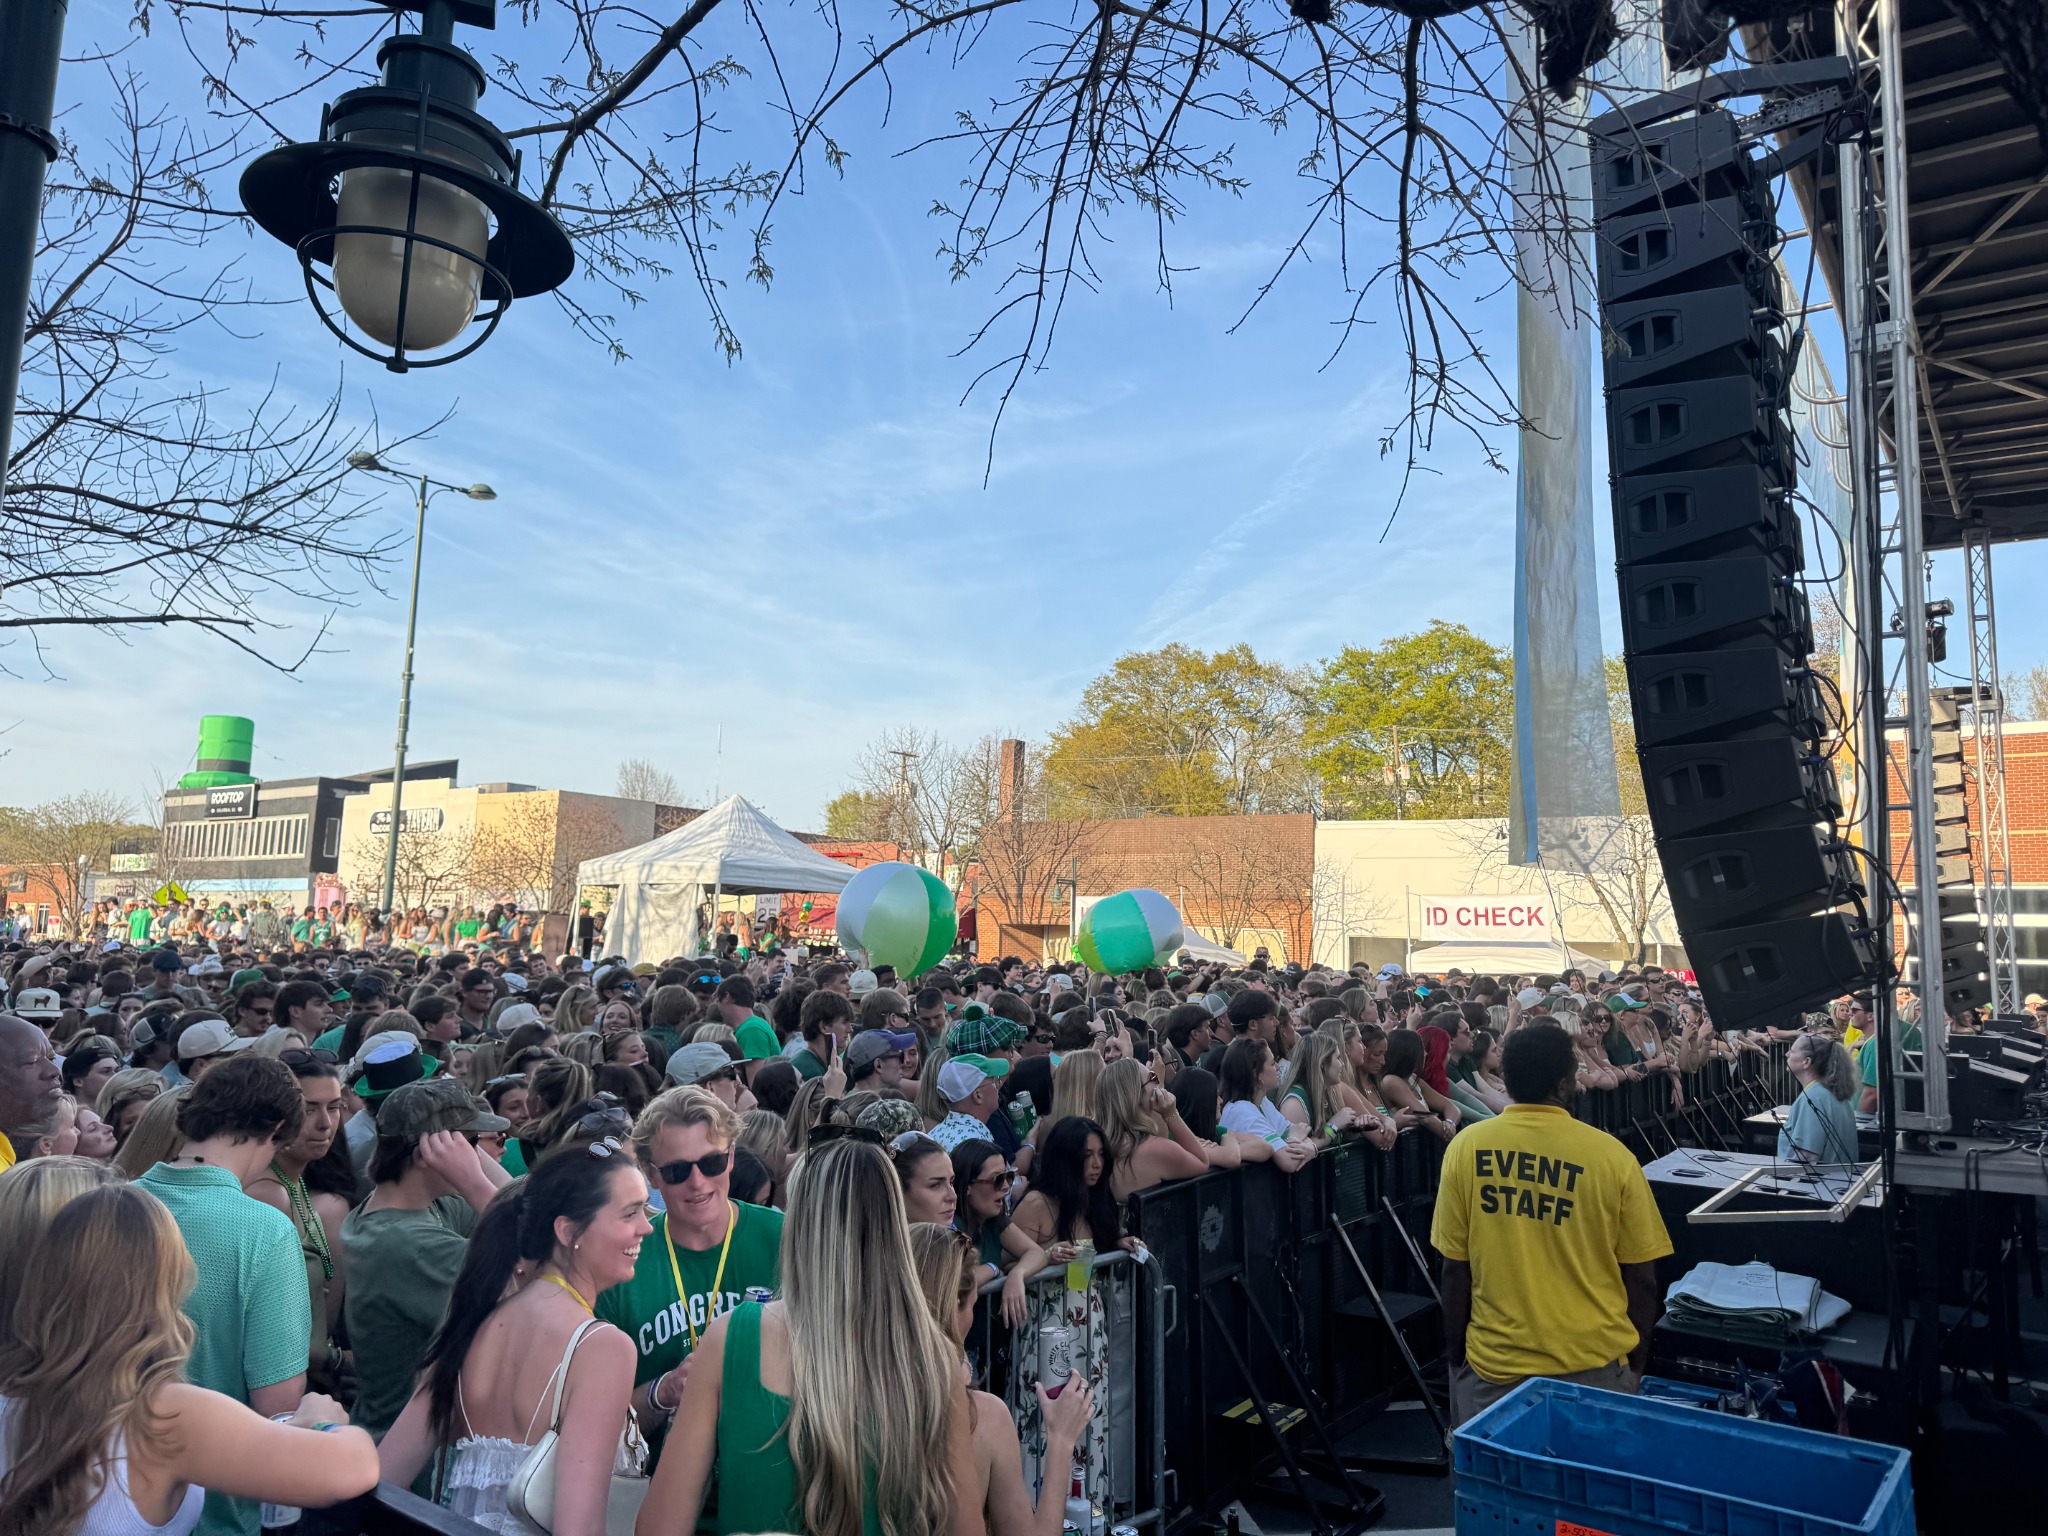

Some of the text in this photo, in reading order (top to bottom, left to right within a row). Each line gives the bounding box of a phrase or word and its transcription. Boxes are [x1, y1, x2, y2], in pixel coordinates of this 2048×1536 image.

[211, 791, 244, 805] ROOFTOP
[406, 808, 440, 833] TAVERN
[757, 908, 777, 923] 25
[1426, 906, 1545, 926] ID CHECK
[1475, 1149, 1584, 1193] EVENT
[1480, 1184, 1574, 1226] STAFF
[638, 1291, 741, 1356] CONGRE
[1048, 1344, 1060, 1366] WHITE
